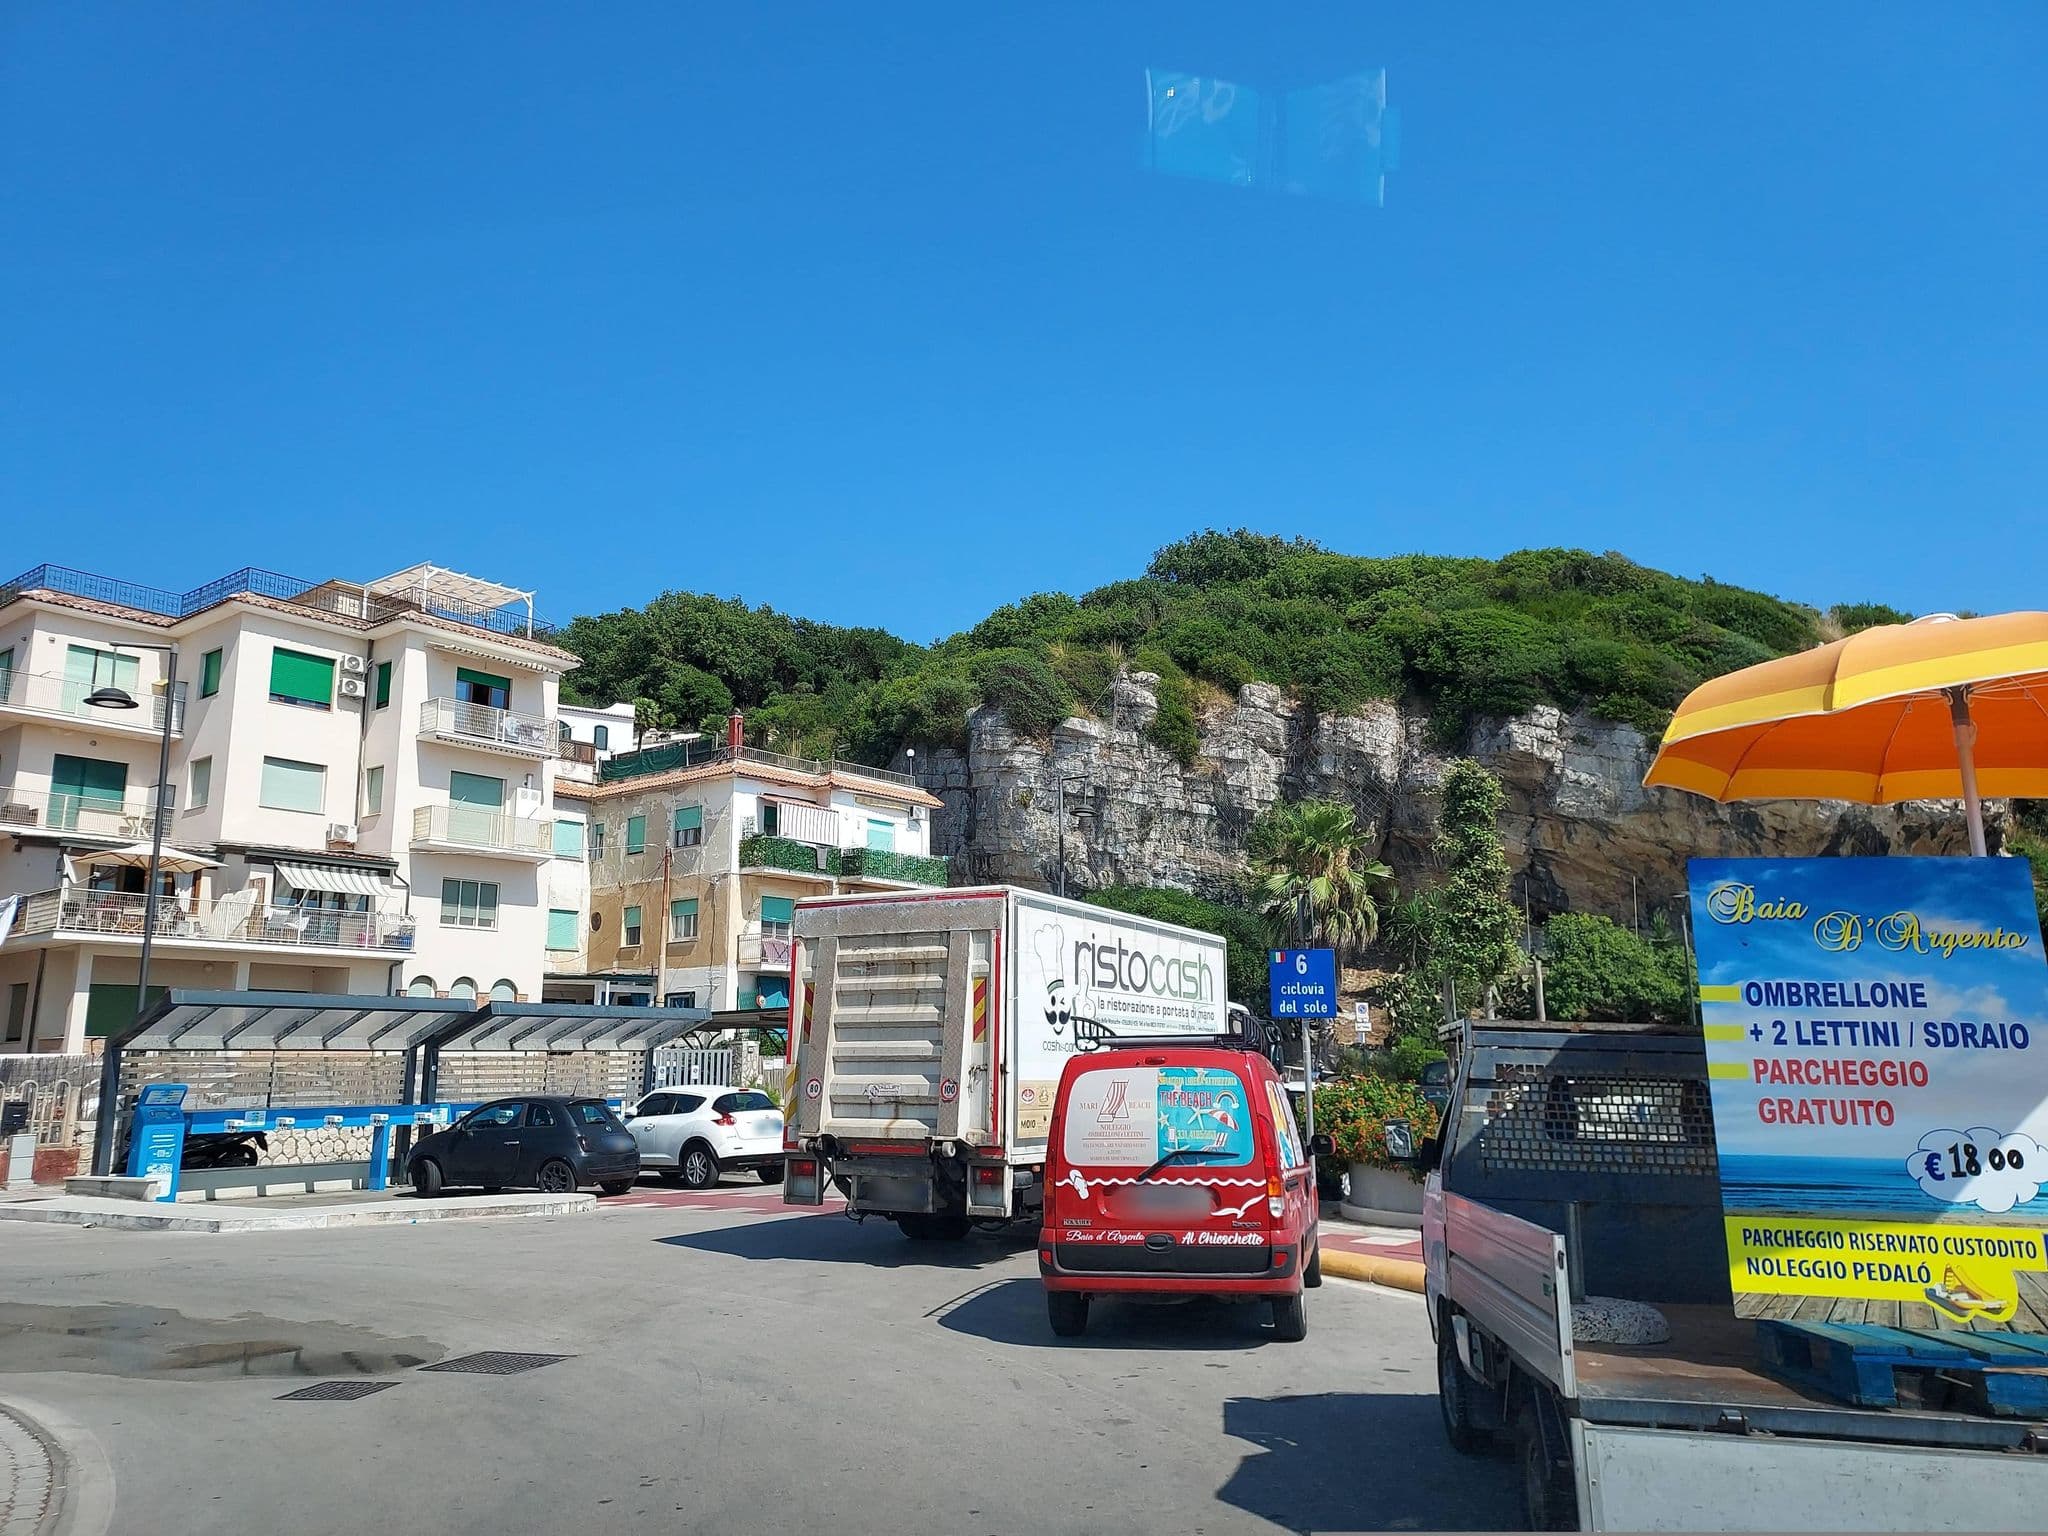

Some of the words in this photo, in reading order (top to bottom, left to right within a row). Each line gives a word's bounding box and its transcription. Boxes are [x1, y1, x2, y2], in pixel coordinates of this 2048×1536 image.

[1706, 882, 1808, 924] Baia
[1074, 932, 1214, 1003] ristocash
[1296, 954, 1307, 974] 6
[1281, 982, 1324, 994] ciclovia
[1745, 981, 1928, 1009] OMBRELLONE
[1097, 995, 1105, 1010] la
[1106, 997, 1155, 1015] ristorazione
[1156, 1007, 1161, 1016] a
[1162, 1004, 1190, 1020] portata
[1280, 1000, 1297, 1013] del
[1304, 1000, 1327, 1013] sole
[1750, 1023, 1763, 1042] +
[1771, 1020, 1788, 1046] 2
[1795, 1020, 1900, 1047] LETTINI
[1909, 1021, 1914, 1048] /
[1924, 1021, 2030, 1050] SDRAIO
[1753, 1058, 1929, 1088] PARCHEGGIO
[808, 1084, 819, 1094] 80
[943, 1083, 957, 1096] 100
[1160, 1091, 1179, 1107] THE
[1180, 1091, 1213, 1107] BEACH
[1758, 1098, 1896, 1127] GRATUITO
[1181, 1231, 1196, 1245] Al
[1198, 1231, 1265, 1245] Chioschetto
[1743, 1228, 1844, 1249] PARCHEGGIO
[1850, 1232, 1939, 1255] RISERVATO
[1943, 1237, 2037, 1259] CUSTODITO
[1747, 1257, 1846, 1280] NOLEGGIO
